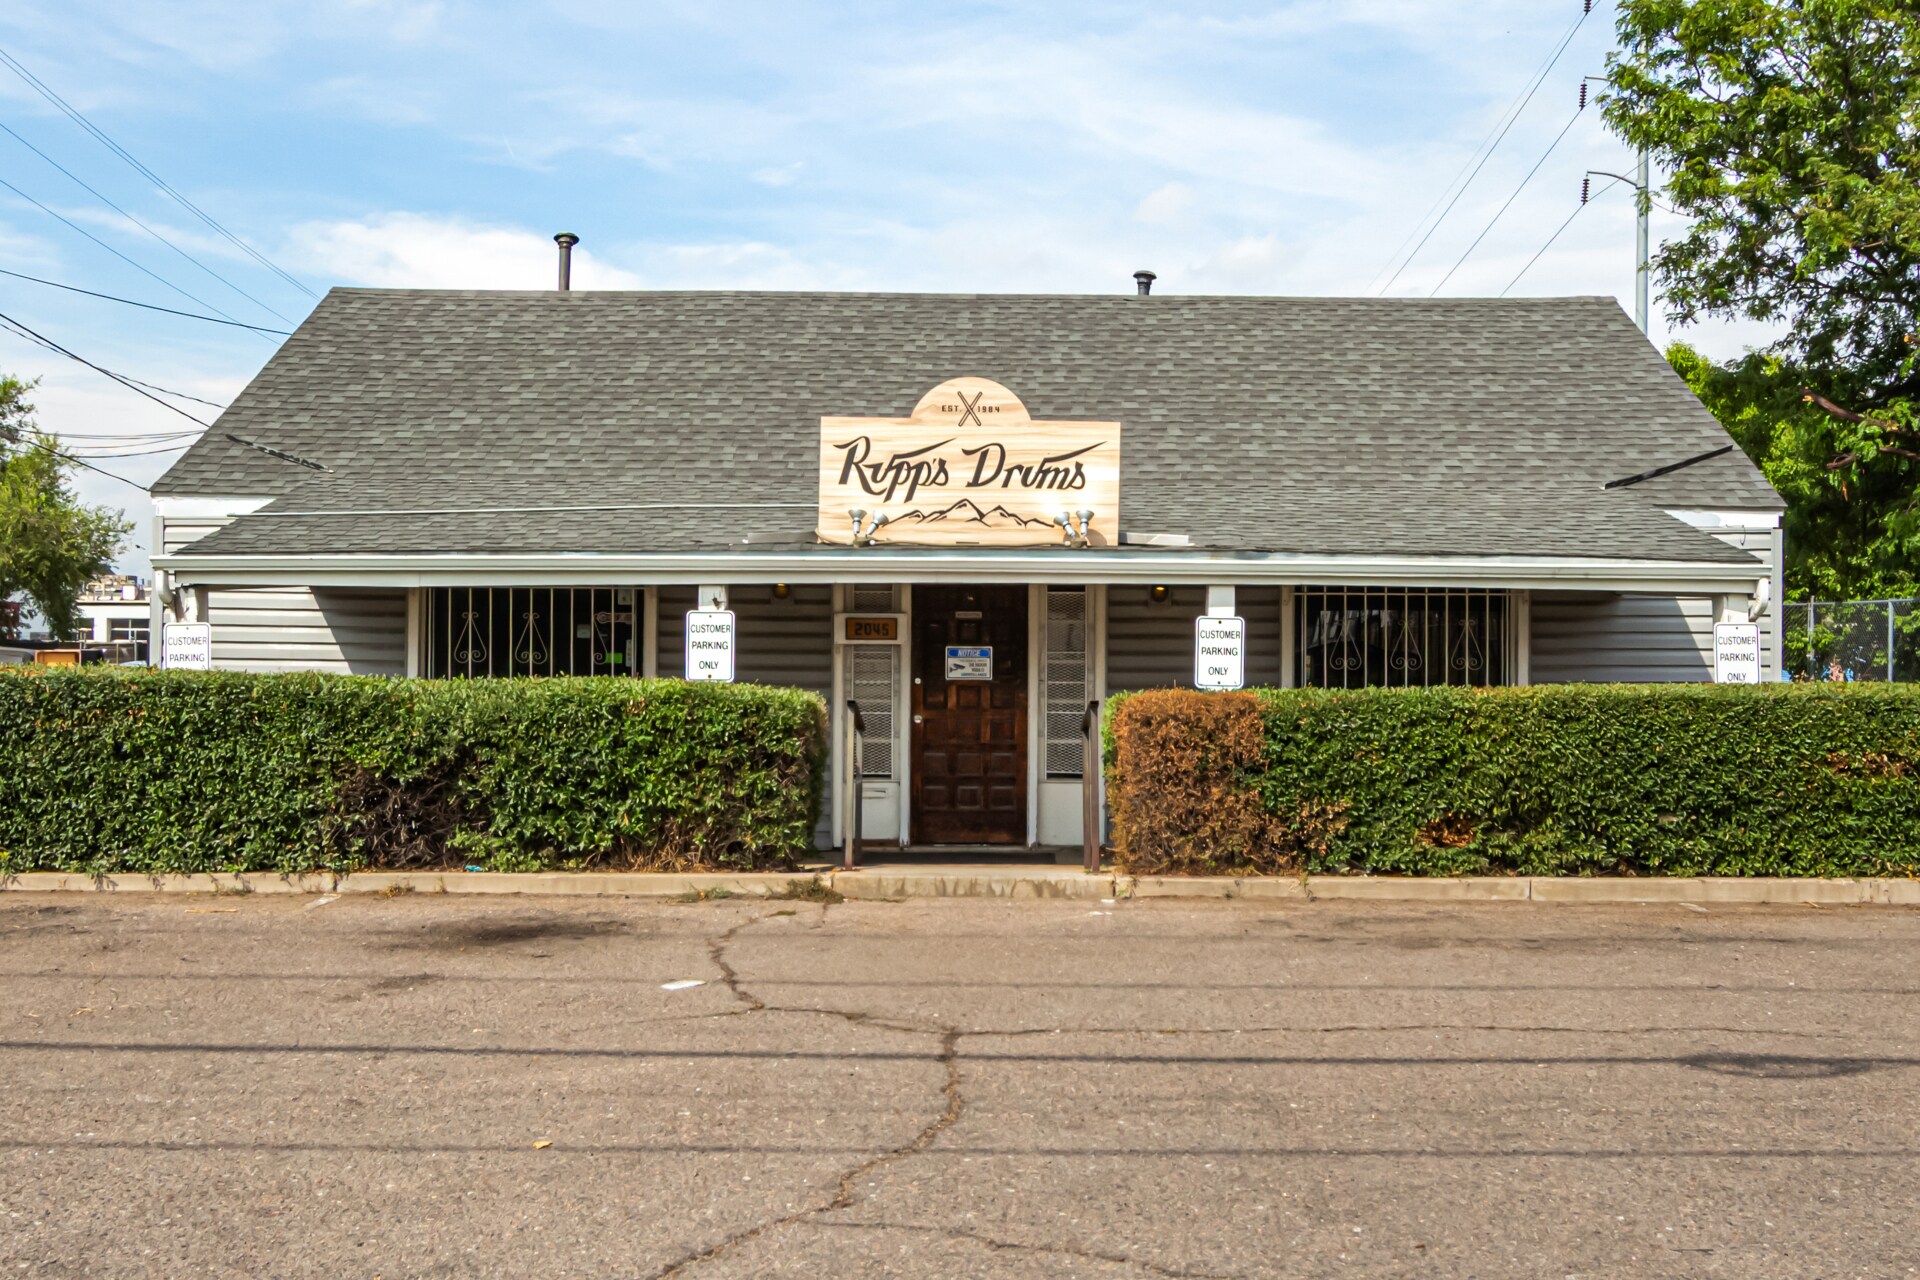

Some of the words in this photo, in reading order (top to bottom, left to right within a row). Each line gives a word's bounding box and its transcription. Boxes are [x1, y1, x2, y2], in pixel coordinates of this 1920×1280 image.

[833, 436, 957, 503] Rupp's
[961, 441, 1107, 490] Drums
[690, 624, 731, 633] CUSTOMER
[855, 622, 889, 636] 2045
[1200, 630, 1241, 639] CUSTOMER
[168, 637, 207, 645] CUSTOMER
[691, 641, 729, 650] PARKING
[1718, 637, 1756, 645] CUSTOMER
[1201, 647, 1238, 656] PARKING
[169, 654, 205, 662] PARKING
[1720, 653, 1755, 661] PARKING
[699, 660, 719, 669] ONLY
[1208, 667, 1228, 675] ONLY
[1727, 673, 1746, 681] ONLY
